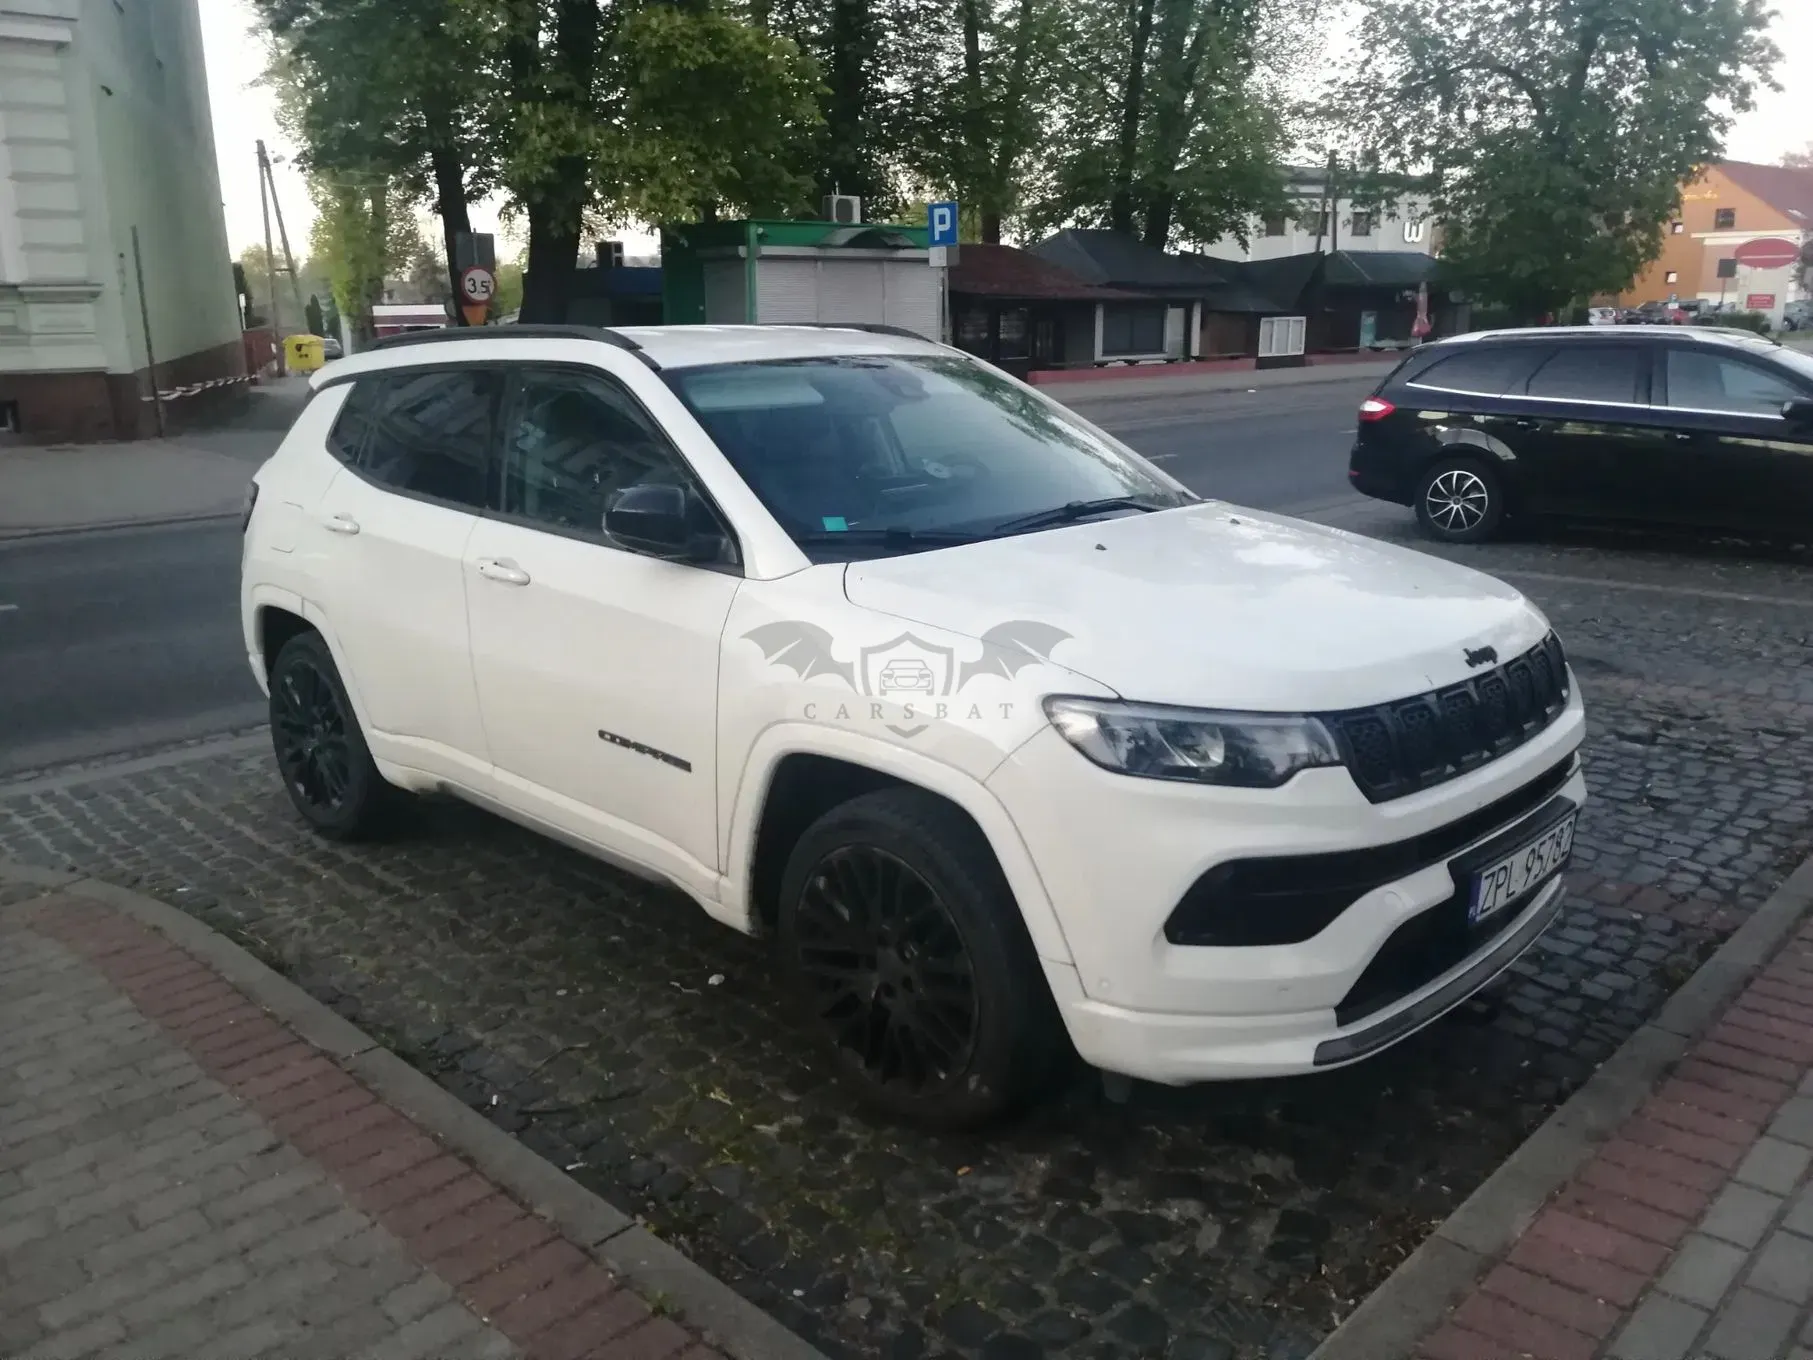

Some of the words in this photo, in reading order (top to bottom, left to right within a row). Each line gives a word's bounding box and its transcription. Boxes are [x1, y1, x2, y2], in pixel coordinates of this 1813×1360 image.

[933, 207, 951, 241] P
[1481, 860, 1516, 914] ZPL
[1524, 820, 1574, 888] 95782
